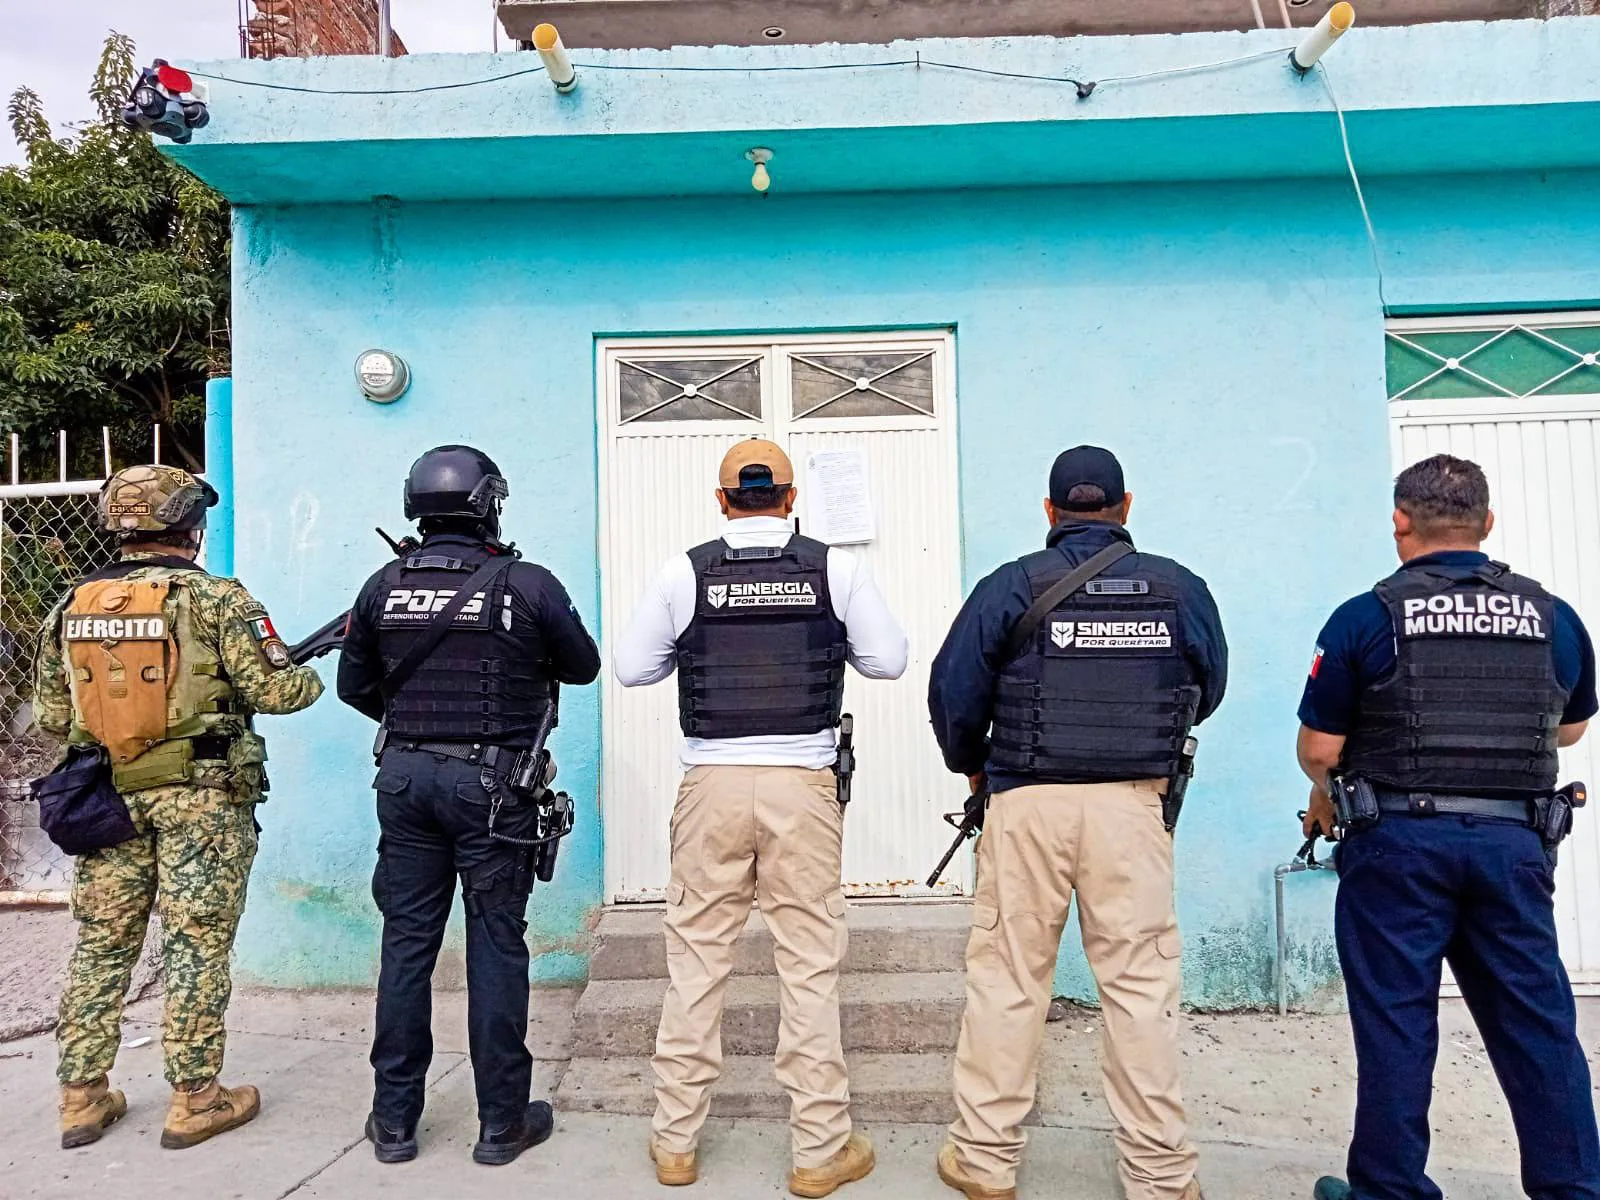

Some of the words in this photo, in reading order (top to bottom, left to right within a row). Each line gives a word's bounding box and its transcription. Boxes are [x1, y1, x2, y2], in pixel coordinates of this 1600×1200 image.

[729, 582, 814, 595] SINERGIA
[1404, 594, 1541, 621] POLICÍA
[66, 616, 164, 639] EJÉRCITO
[1077, 622, 1169, 635] SINERGIA
[1405, 614, 1546, 639] MUNICIPAL
